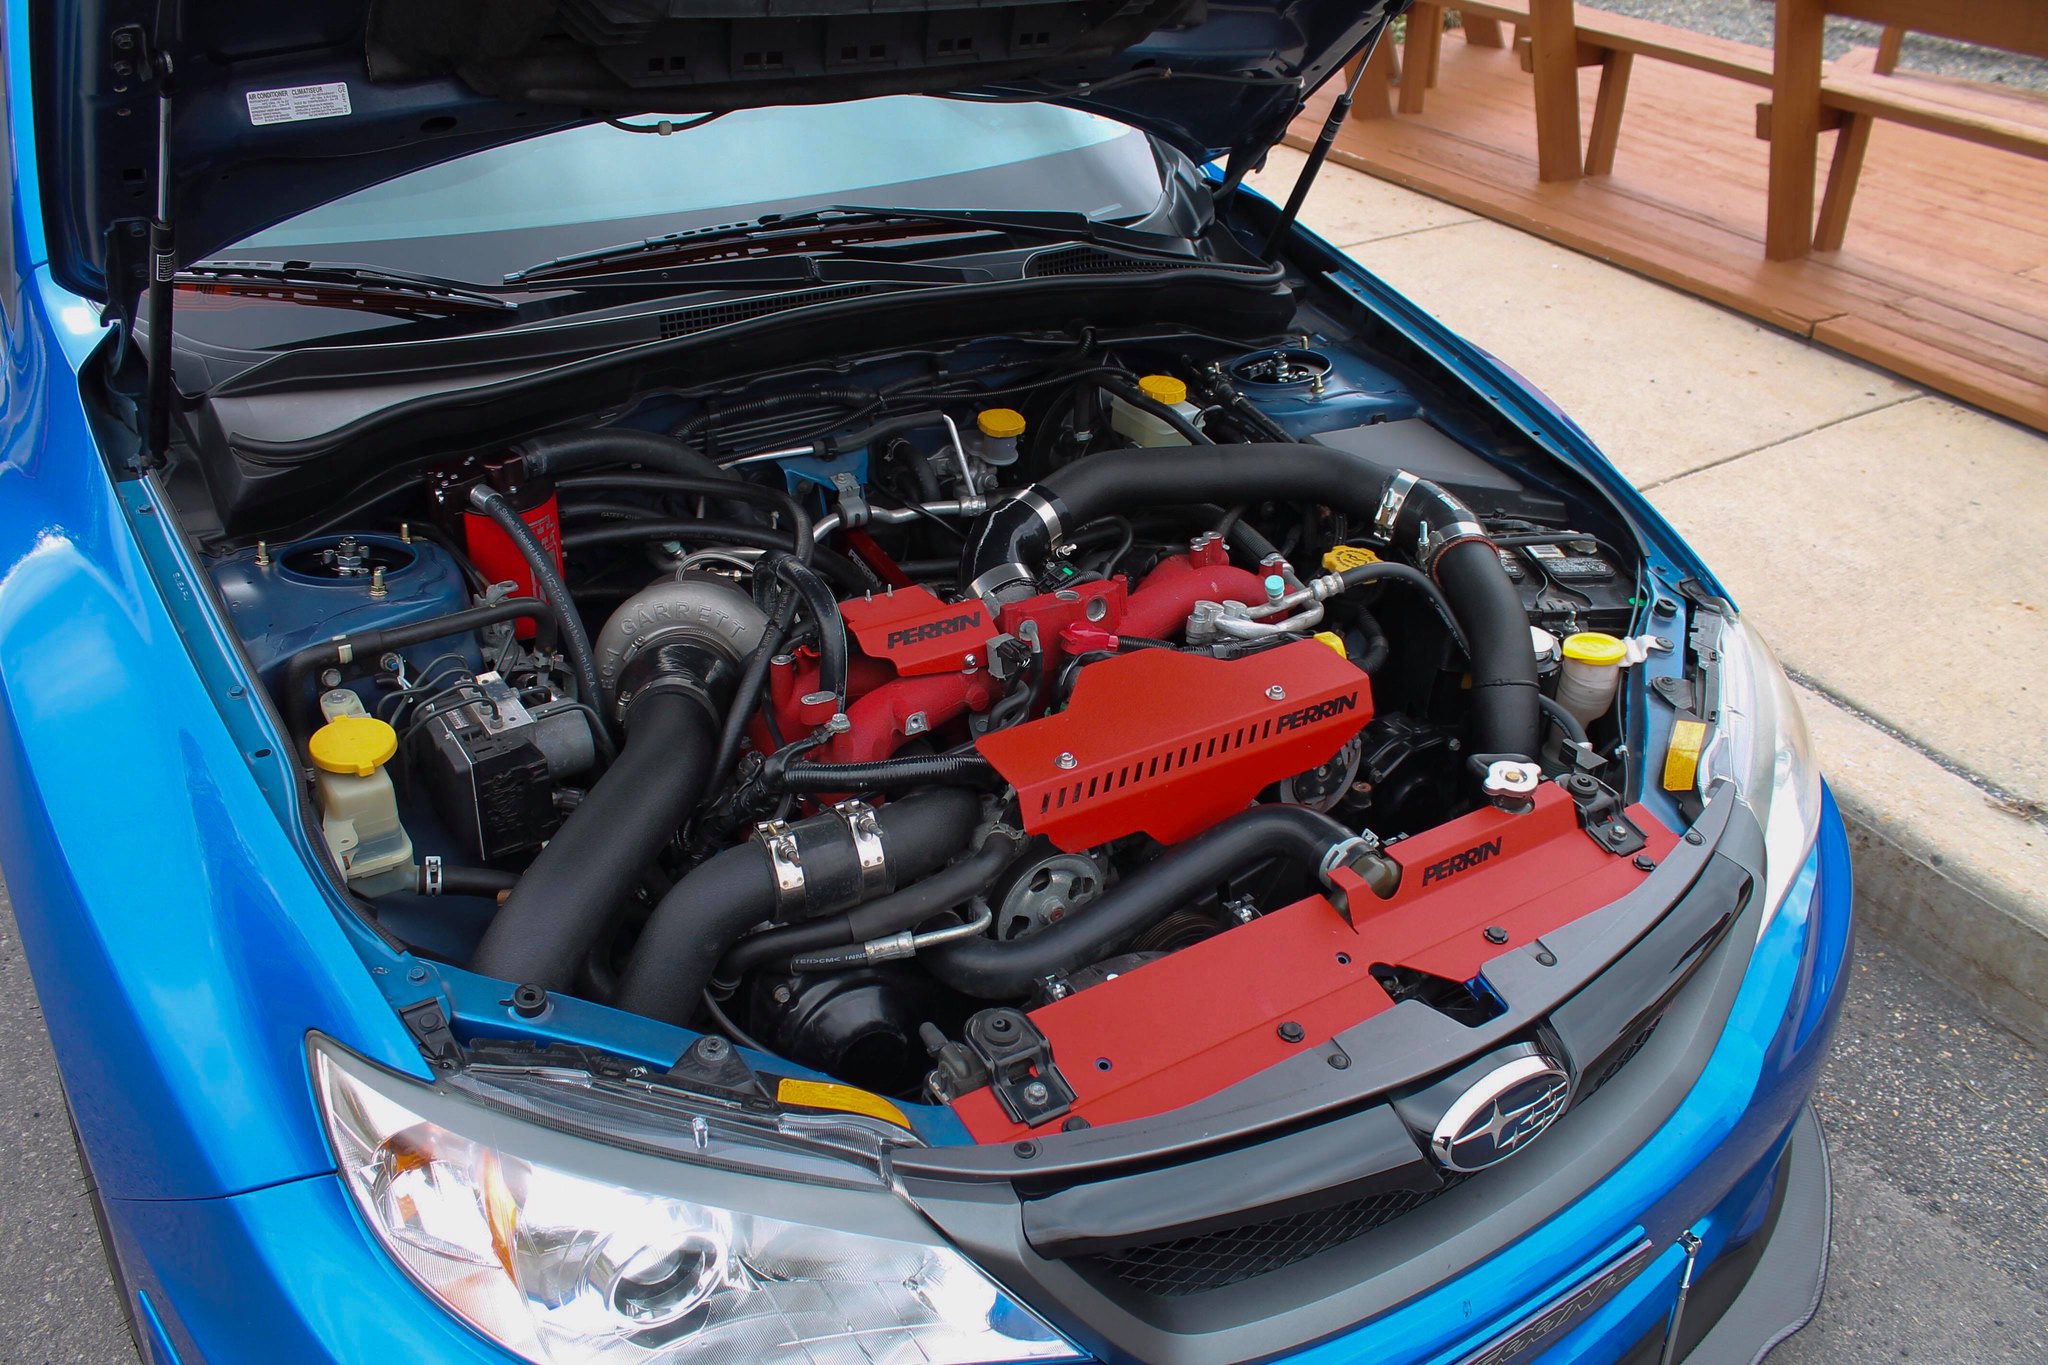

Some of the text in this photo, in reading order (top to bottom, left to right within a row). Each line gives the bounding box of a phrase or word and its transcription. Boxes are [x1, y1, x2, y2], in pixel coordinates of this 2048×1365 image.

[257, 90, 288, 99] CONDITIONER
[291, 87, 323, 95] CLIMATISEUR
[517, 528, 535, 552] Heater
[534, 551, 547, 572] Hose
[620, 601, 746, 638] GARRETT
[887, 612, 980, 649] PERRIN
[1276, 691, 1358, 735] PERRIN
[1422, 836, 1502, 887] PERRIN
[1474, 1273, 1615, 1365] ERRIN
